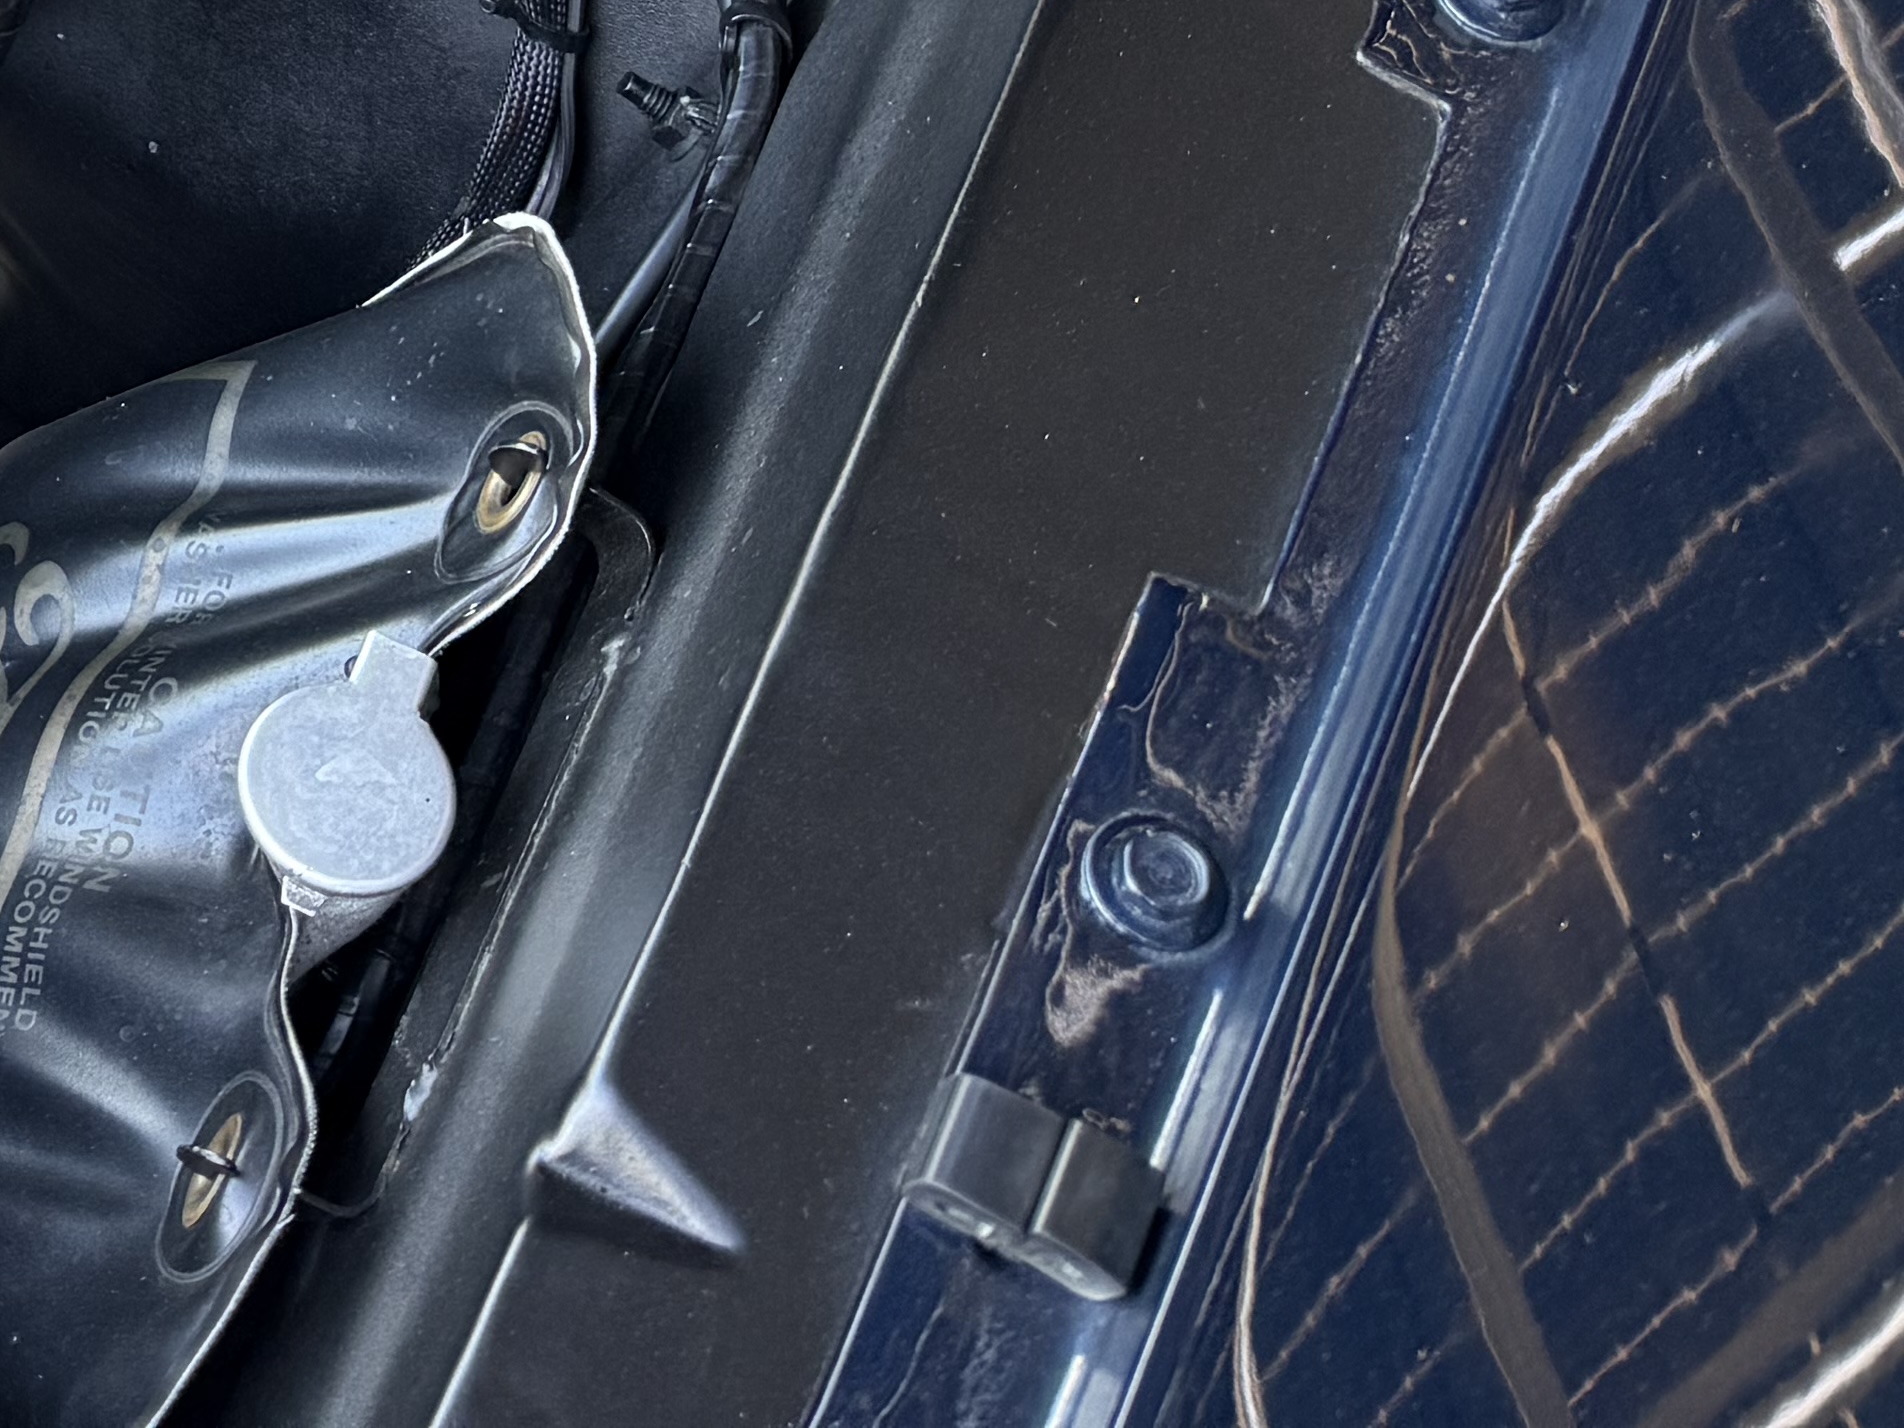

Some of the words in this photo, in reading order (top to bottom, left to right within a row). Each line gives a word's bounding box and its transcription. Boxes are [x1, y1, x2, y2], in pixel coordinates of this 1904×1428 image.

[116, 627, 171, 736] INTER
[53, 787, 86, 828] AS
[84, 674, 180, 894] CATION
[13, 824, 104, 1035] WINDSHIELD
